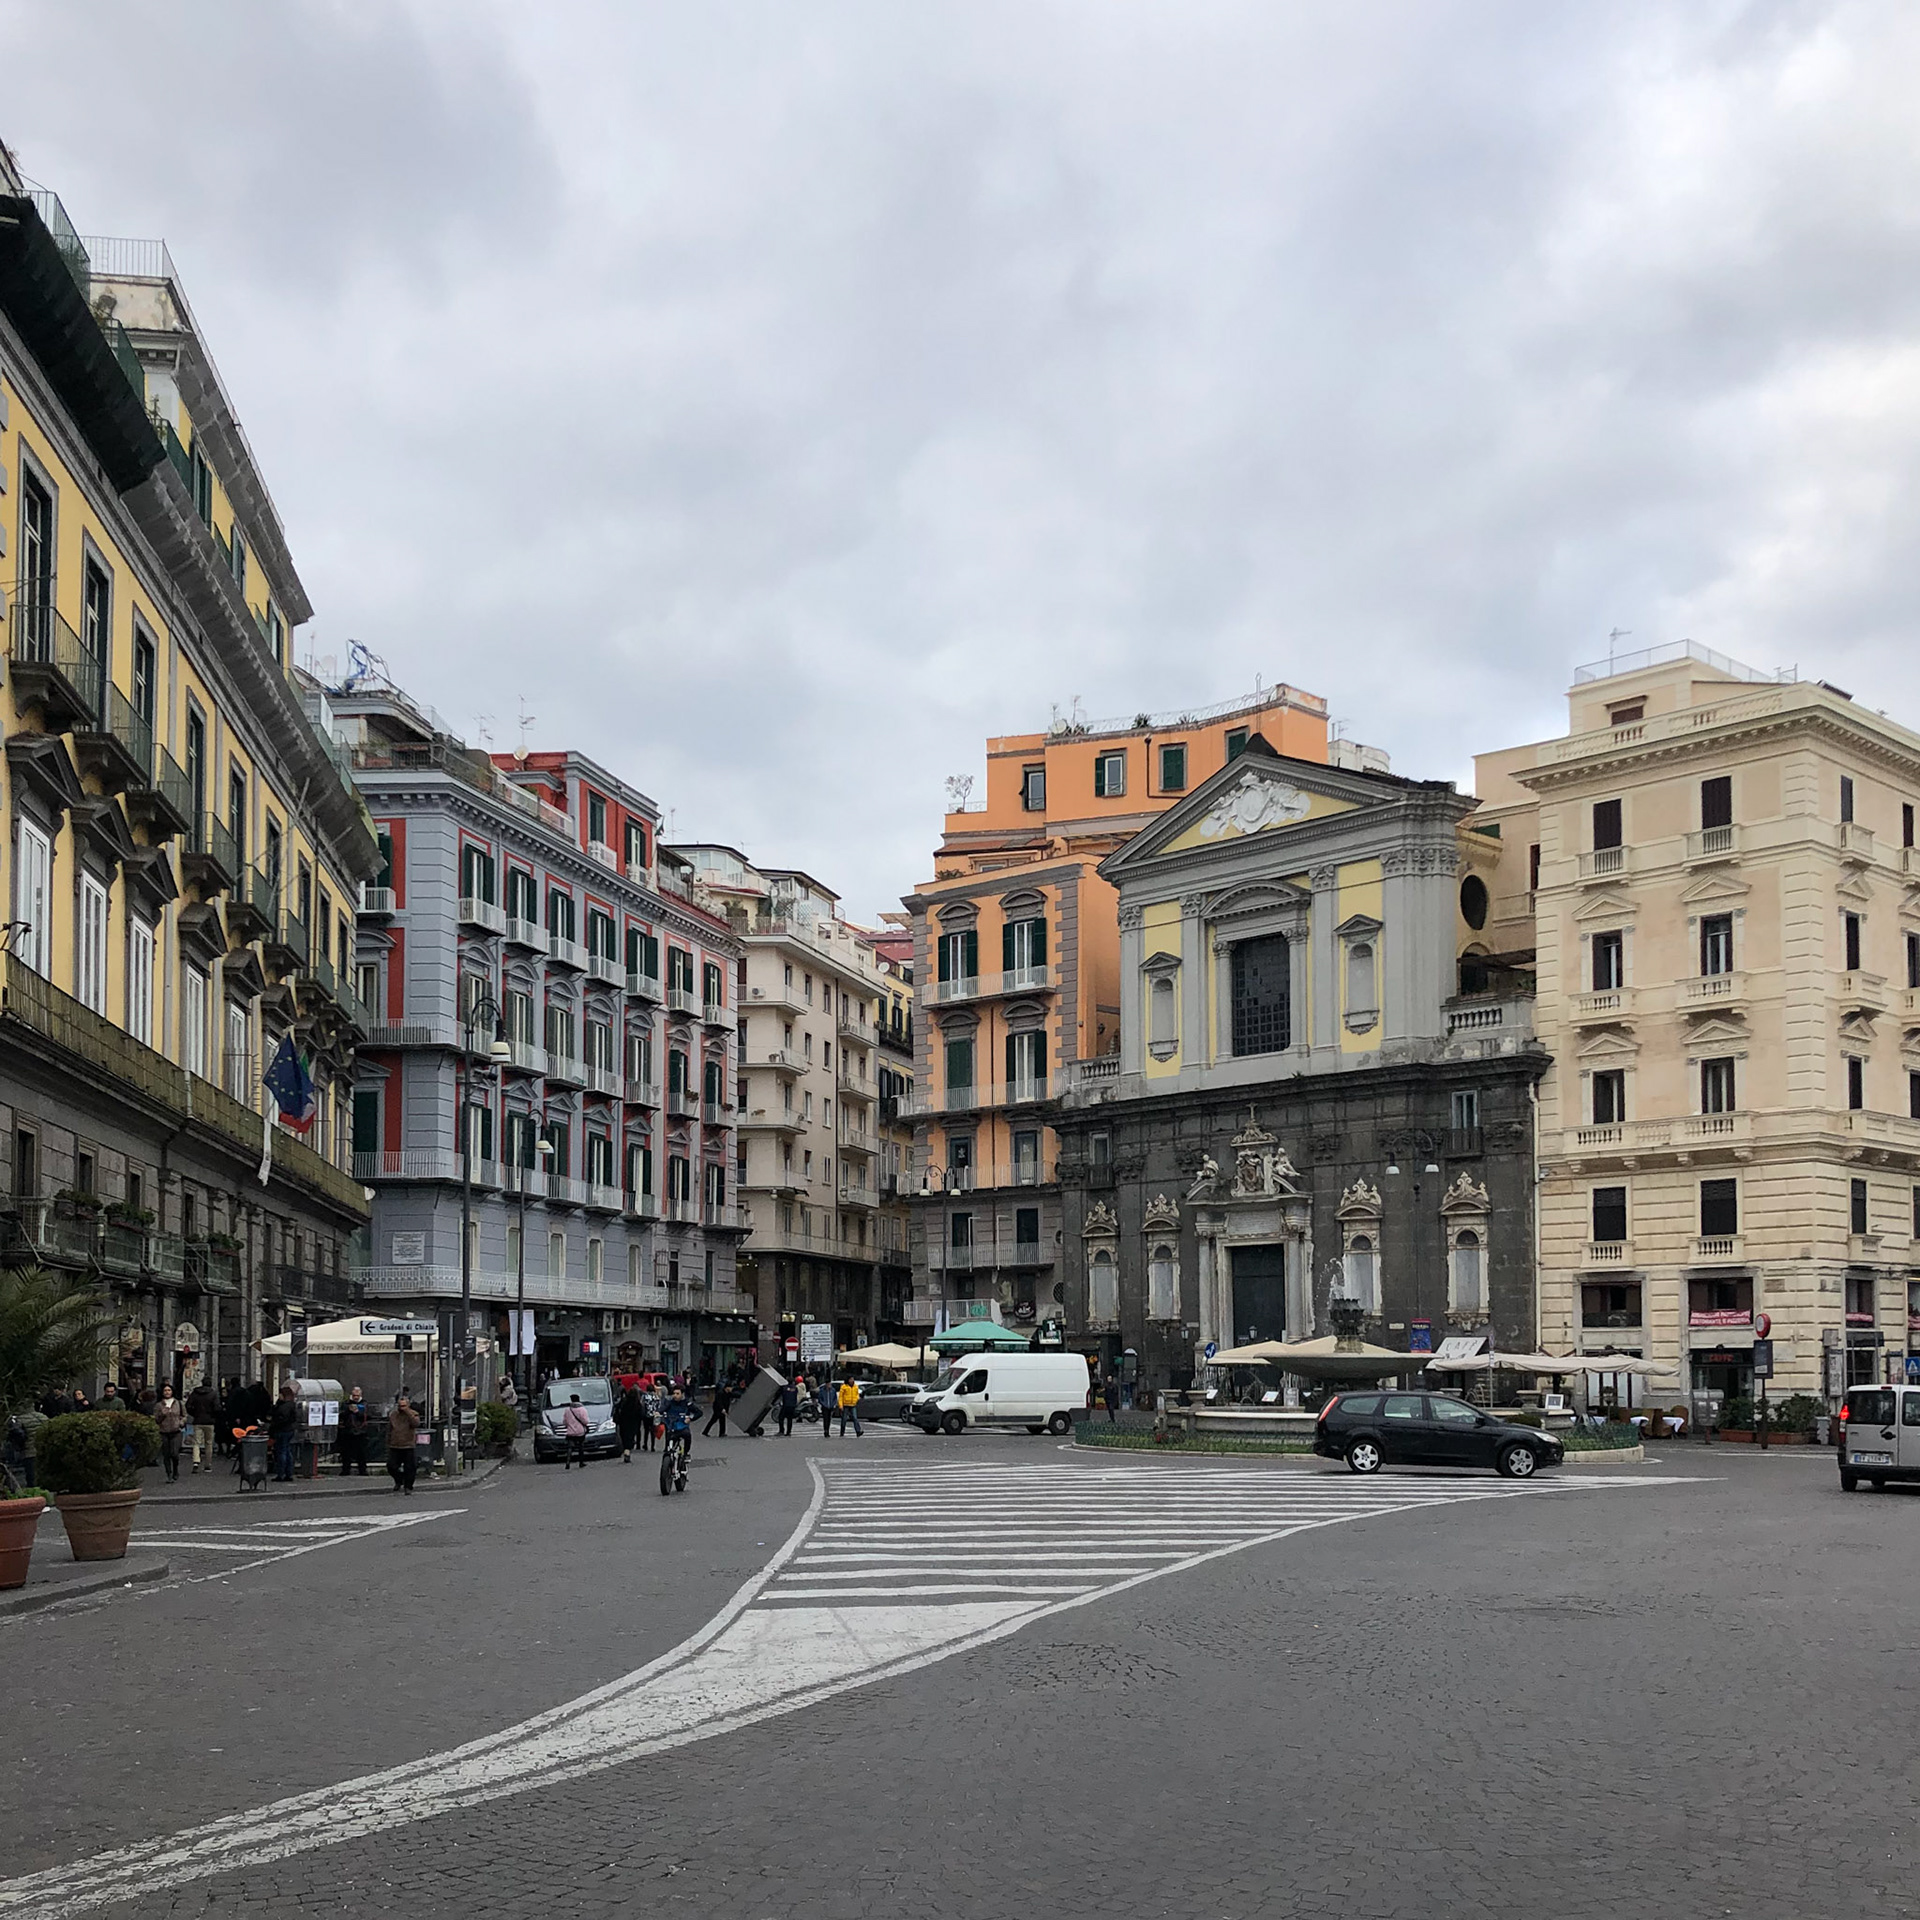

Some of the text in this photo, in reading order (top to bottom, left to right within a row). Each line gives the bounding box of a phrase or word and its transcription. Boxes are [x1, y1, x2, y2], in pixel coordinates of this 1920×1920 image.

[380, 1323, 404, 1331] Gradoni
[415, 1323, 435, 1331] Chiaia
[352, 1342, 365, 1351] del
